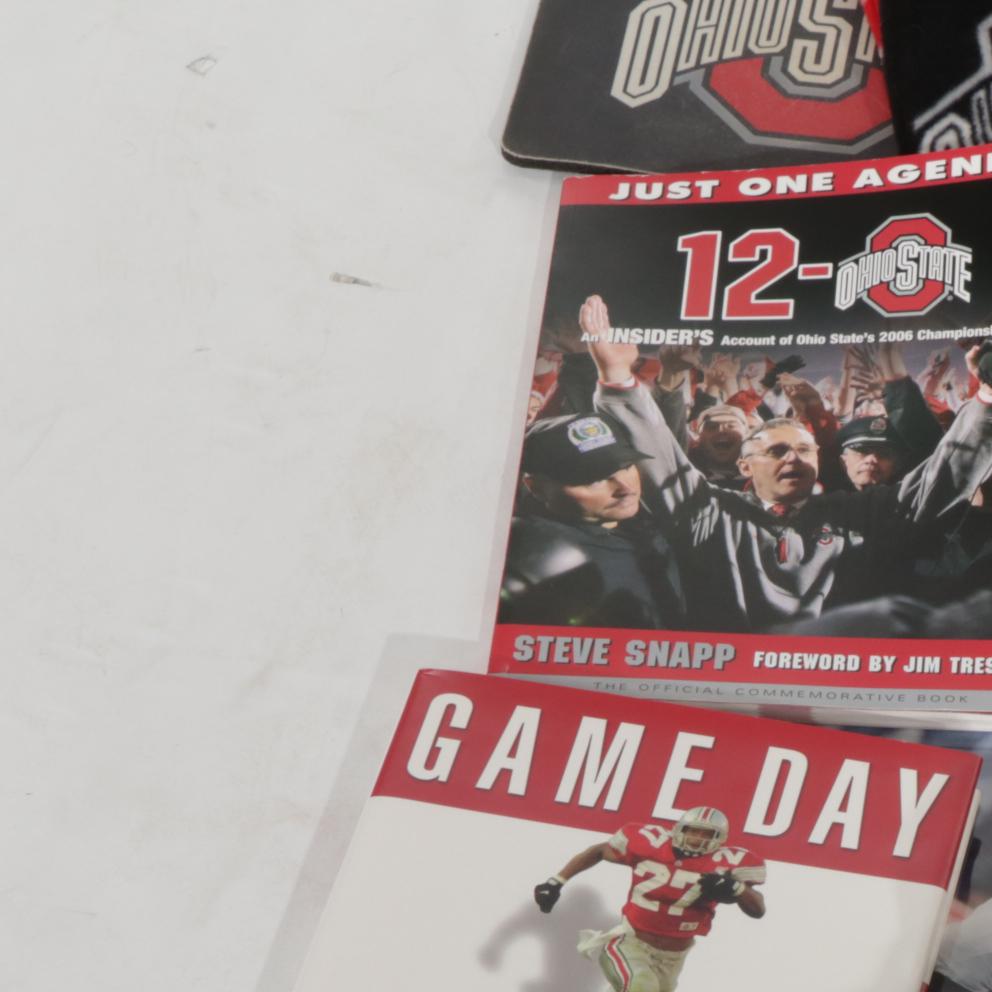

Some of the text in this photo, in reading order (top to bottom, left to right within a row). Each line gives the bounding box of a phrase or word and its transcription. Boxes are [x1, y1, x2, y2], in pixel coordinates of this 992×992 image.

[609, 179, 720, 201] JUST
[738, 172, 834, 197] ONE
[580, 332, 599, 343] An
[607, 328, 715, 345] INSIDER'S
[720, 335, 775, 346] Account
[779, 334, 794, 346] of
[796, 334, 826, 345] Ohio
[830, 332, 875, 345] State's
[879, 330, 914, 343] 2006
[513, 635, 612, 665] STEVE
[624, 639, 736, 670] SNAPP
[752, 651, 860, 671] FOREWORD
[868, 655, 896, 672] BY
[903, 656, 941, 673] JIM
[593, 681, 969, 704] THE OFFICIAL COMMEMORATIVE BOOK
[406, 693, 950, 859] GAME DAY
[630, 860, 702, 917] 27
